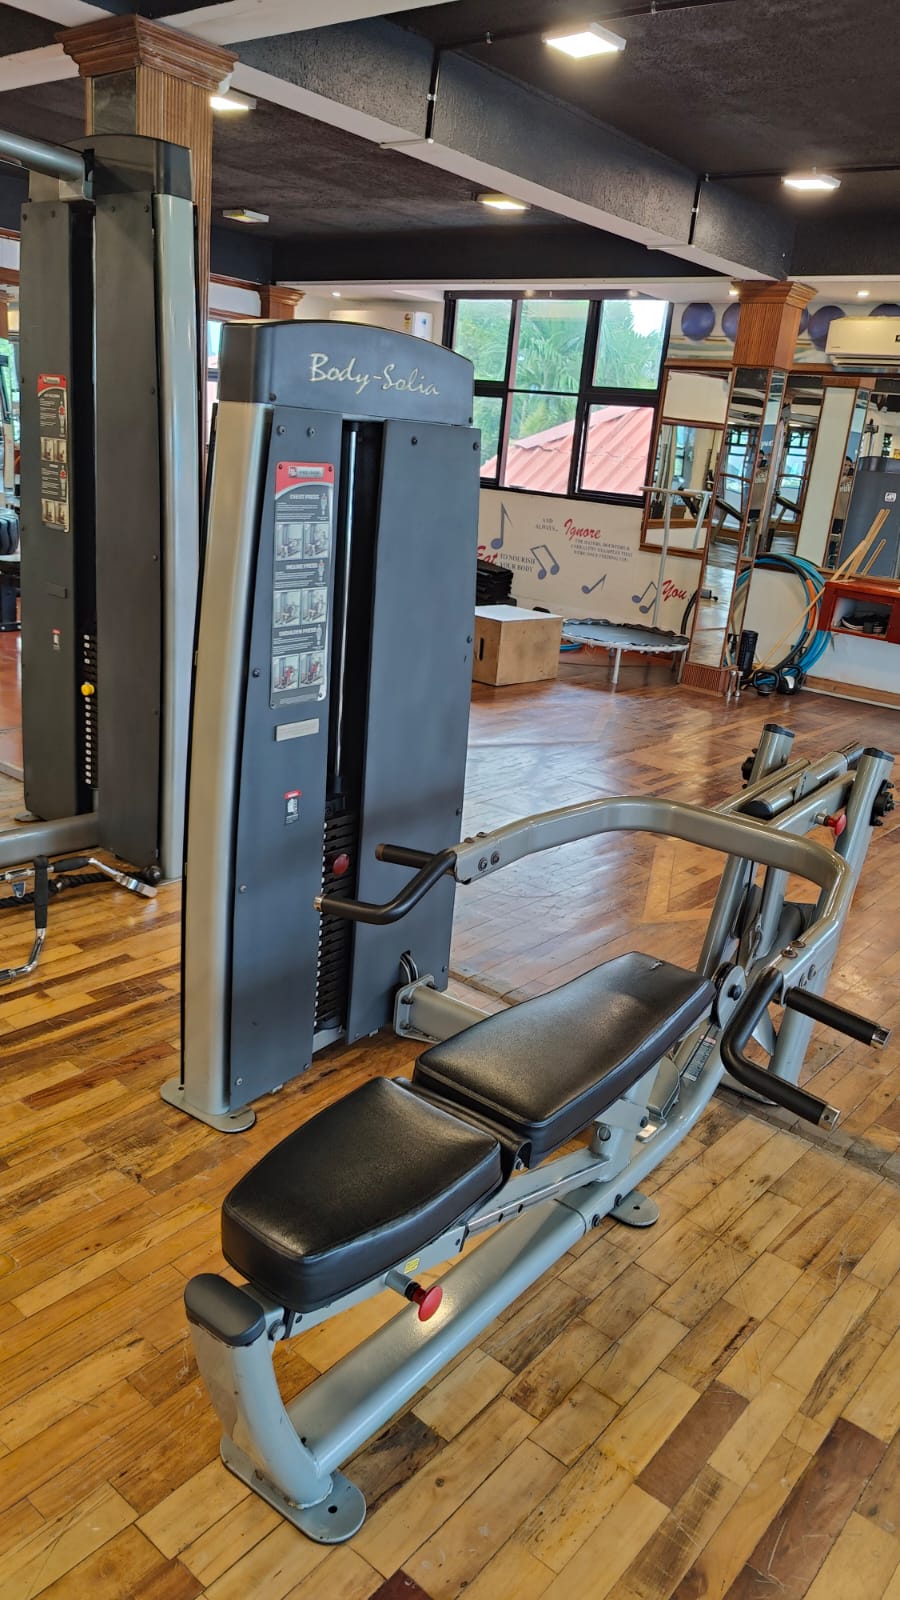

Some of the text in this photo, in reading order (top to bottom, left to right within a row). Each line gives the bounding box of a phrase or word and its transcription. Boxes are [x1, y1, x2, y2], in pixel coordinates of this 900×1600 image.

[564, 518, 601, 541] Ignore
[508, 554, 536, 565] NOURISH
[517, 563, 534, 573] BODY
[662, 579, 688, 602] You
